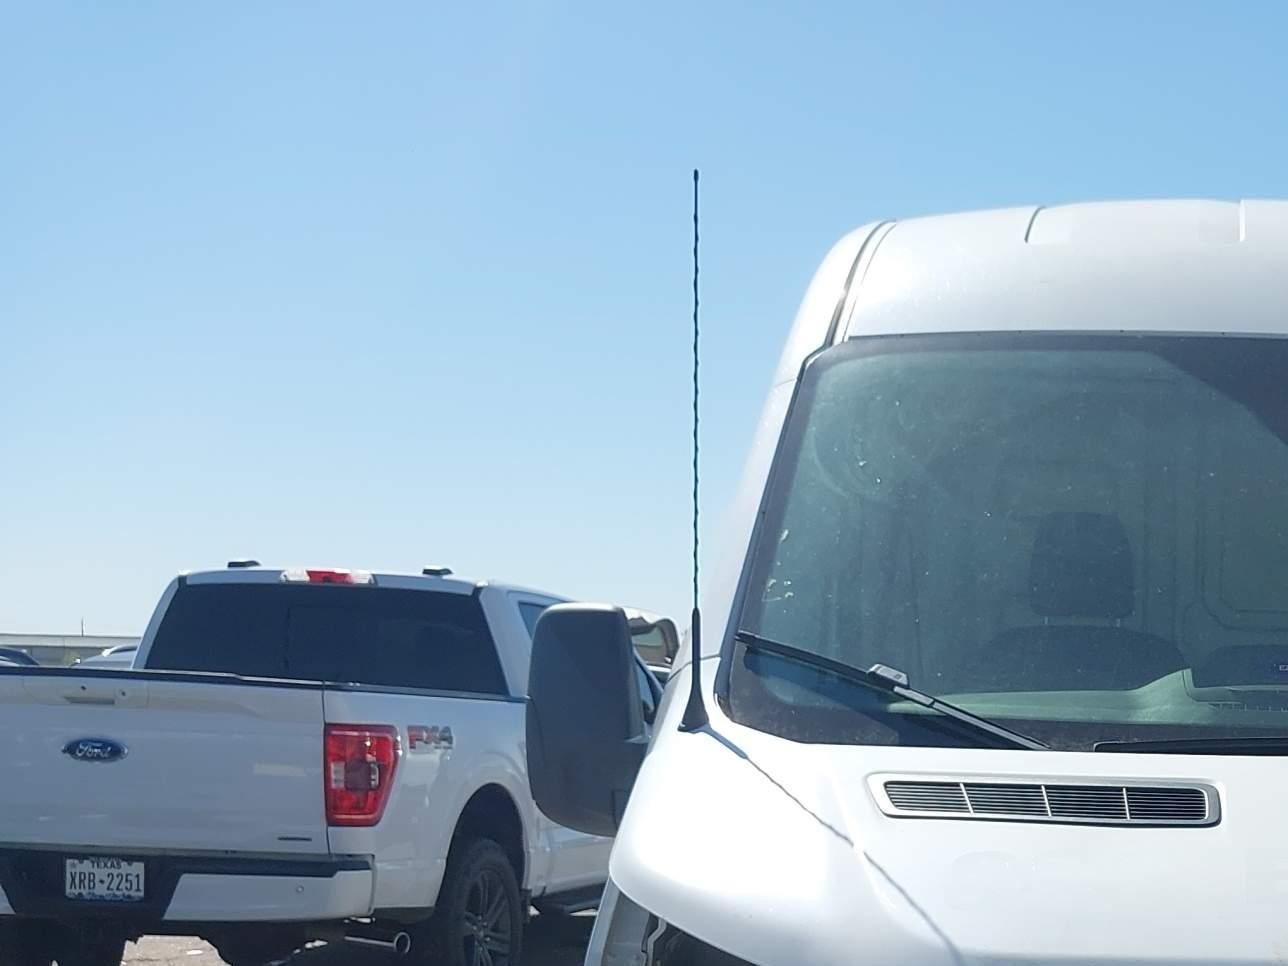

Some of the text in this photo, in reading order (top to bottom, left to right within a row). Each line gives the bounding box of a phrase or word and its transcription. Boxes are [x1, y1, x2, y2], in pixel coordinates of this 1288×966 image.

[407, 725, 453, 750] FX4
[76, 742, 112, 757] Ford
[91, 858, 122, 869] TEXAS
